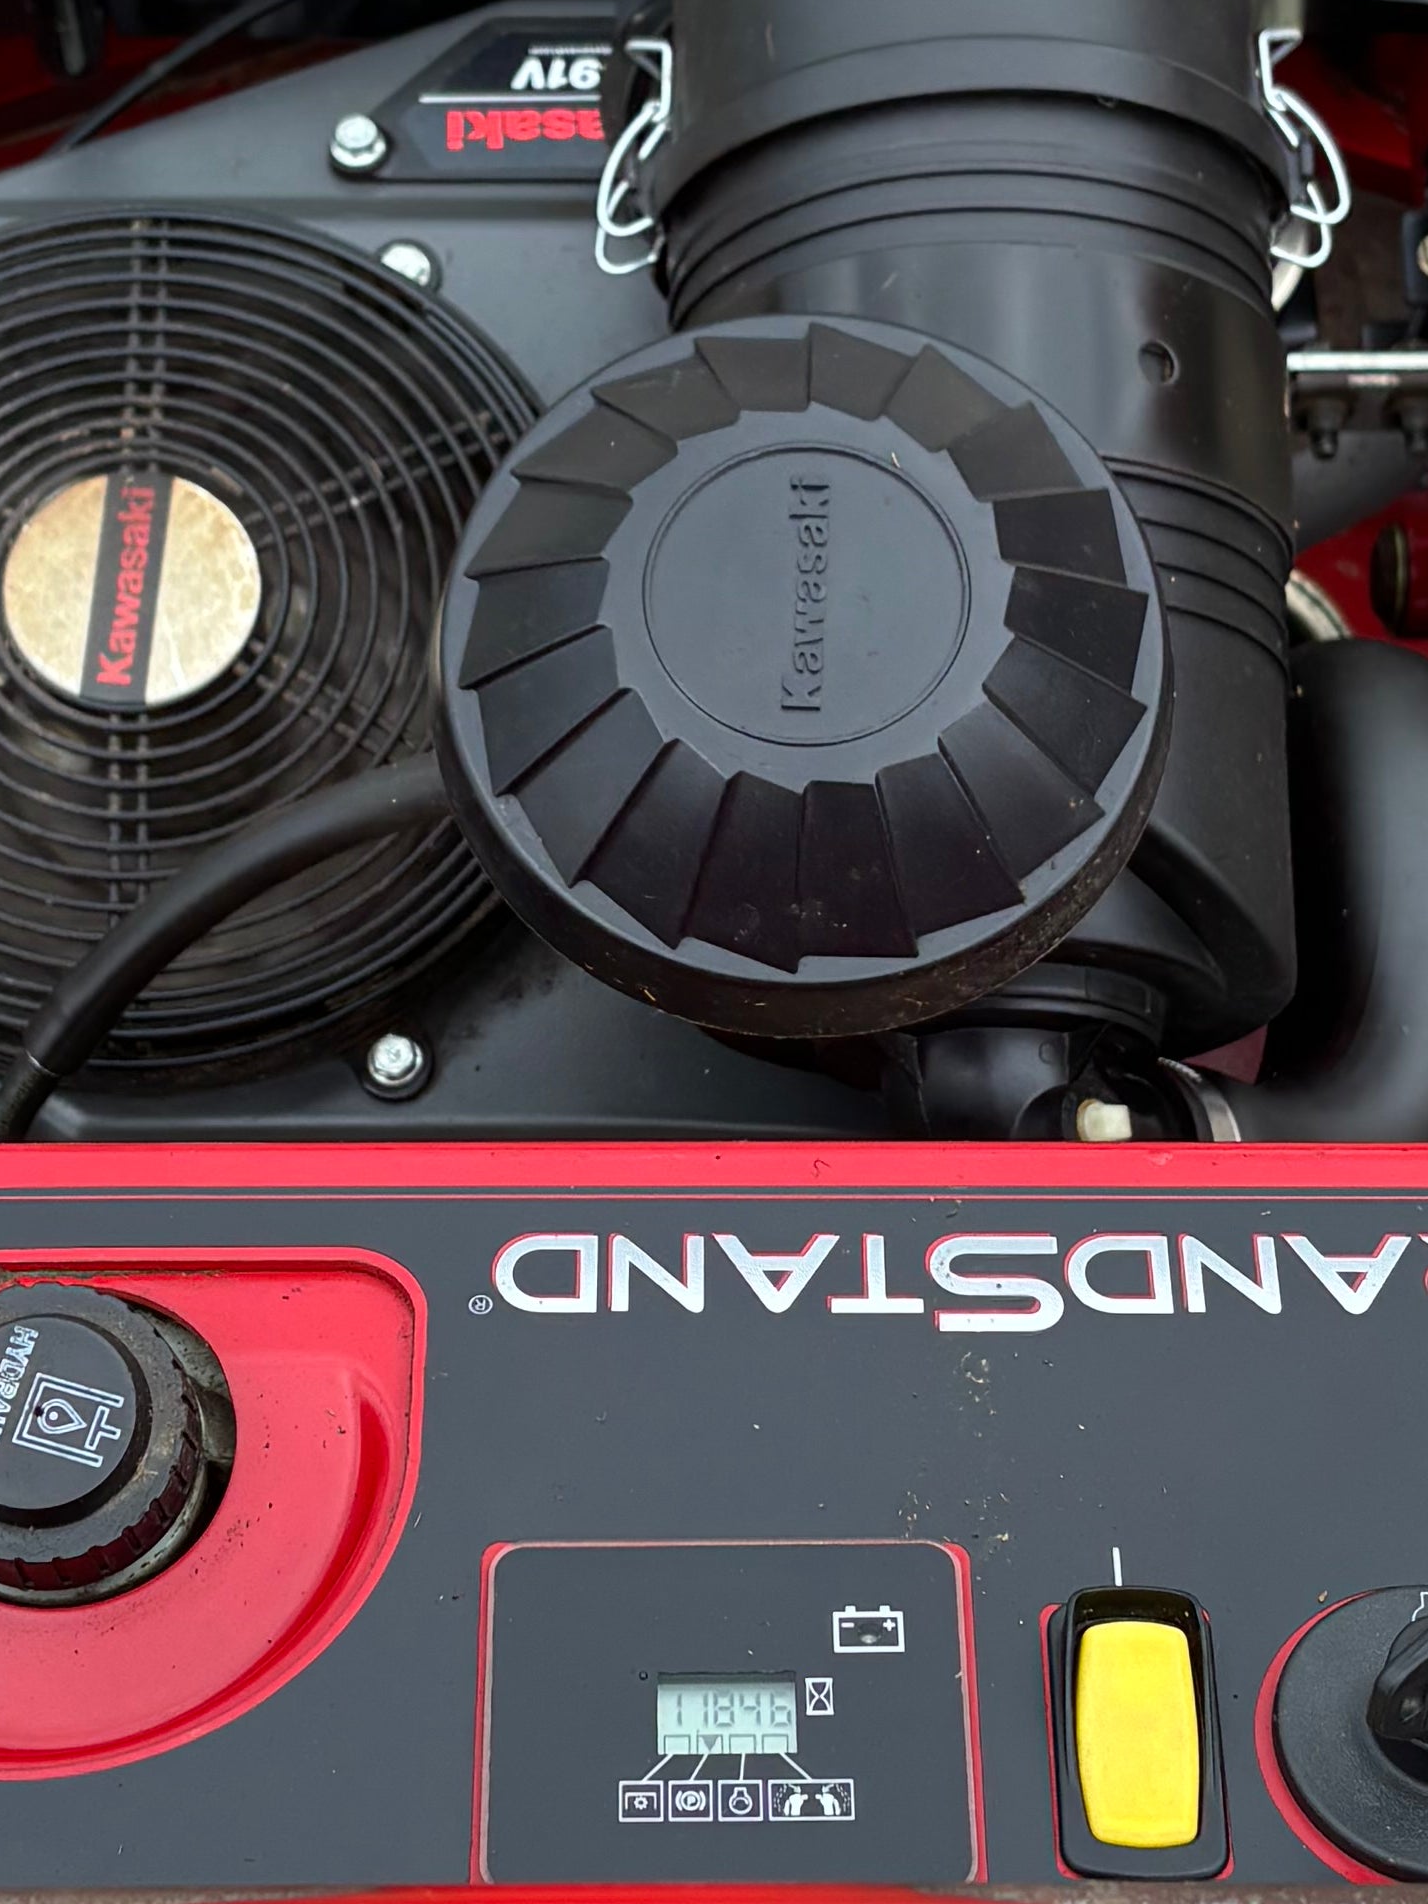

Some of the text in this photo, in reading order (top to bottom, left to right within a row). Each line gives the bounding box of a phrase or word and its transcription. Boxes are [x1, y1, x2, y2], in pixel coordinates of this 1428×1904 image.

[446, 108, 606, 152] asaki
[510, 56, 606, 90] 91V
[95, 486, 156, 686] Kawasaki
[780, 474, 830, 712] Kawasaki
